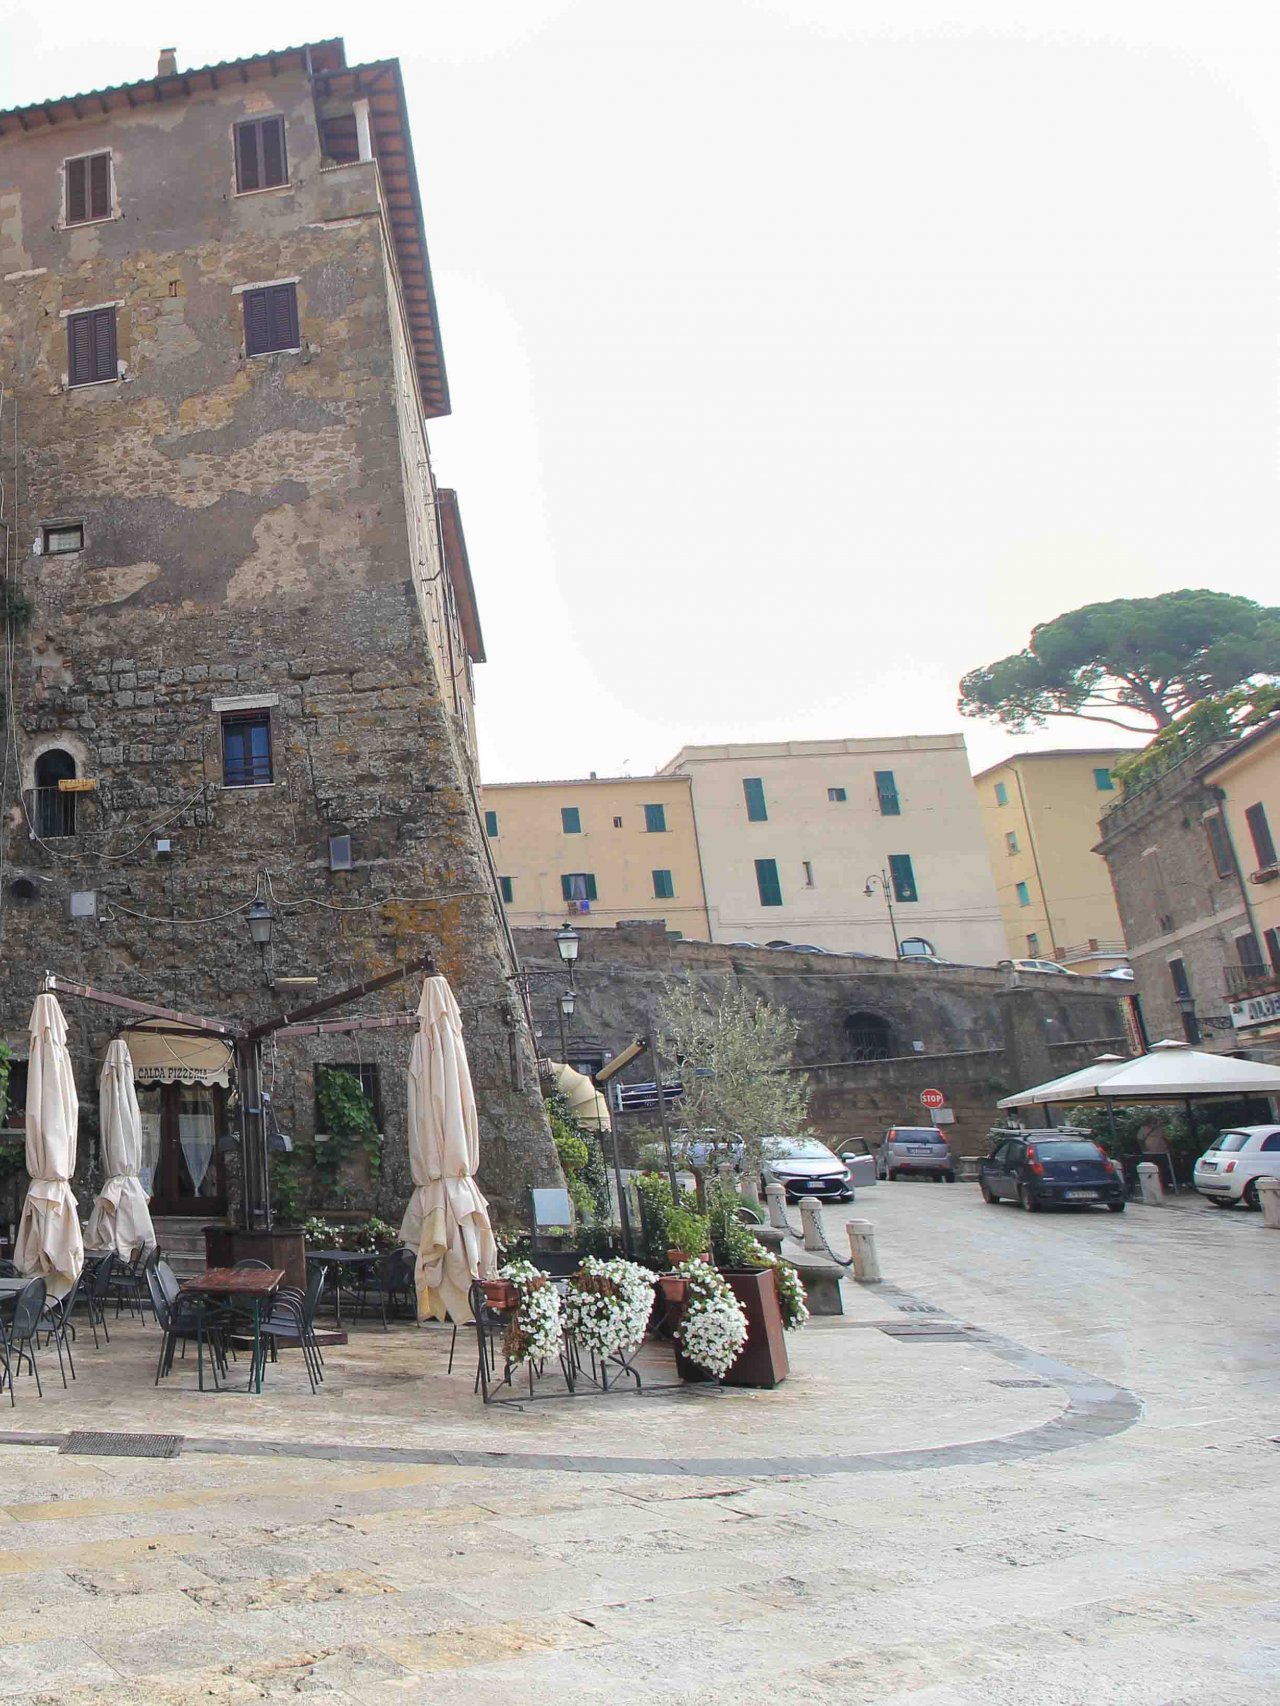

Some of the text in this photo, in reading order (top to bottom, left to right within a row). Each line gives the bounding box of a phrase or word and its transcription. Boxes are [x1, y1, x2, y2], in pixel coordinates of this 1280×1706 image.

[138, 1067, 165, 1079] CALDA
[168, 1067, 208, 1080] PIZZERIA
[921, 1095, 942, 1103] STOP
